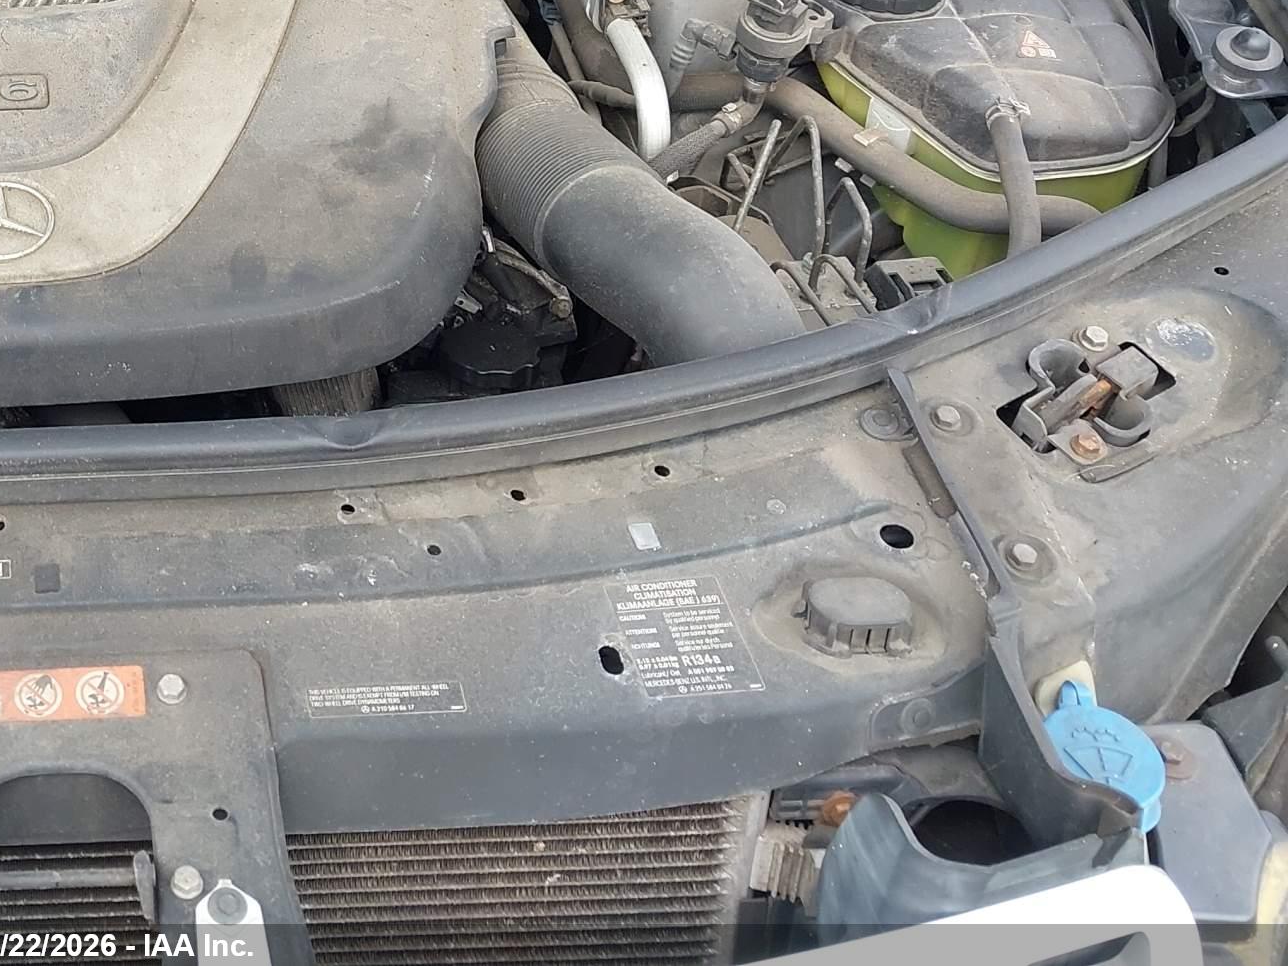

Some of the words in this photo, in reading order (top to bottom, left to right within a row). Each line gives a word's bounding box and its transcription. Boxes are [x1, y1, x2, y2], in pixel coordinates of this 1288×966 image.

[626, 584, 640, 592] AIR
[641, 580, 698, 590] CONDITIONER
[634, 588, 696, 600] CLIMATISATION
[616, 598, 675, 610] KLIMAANLAGE
